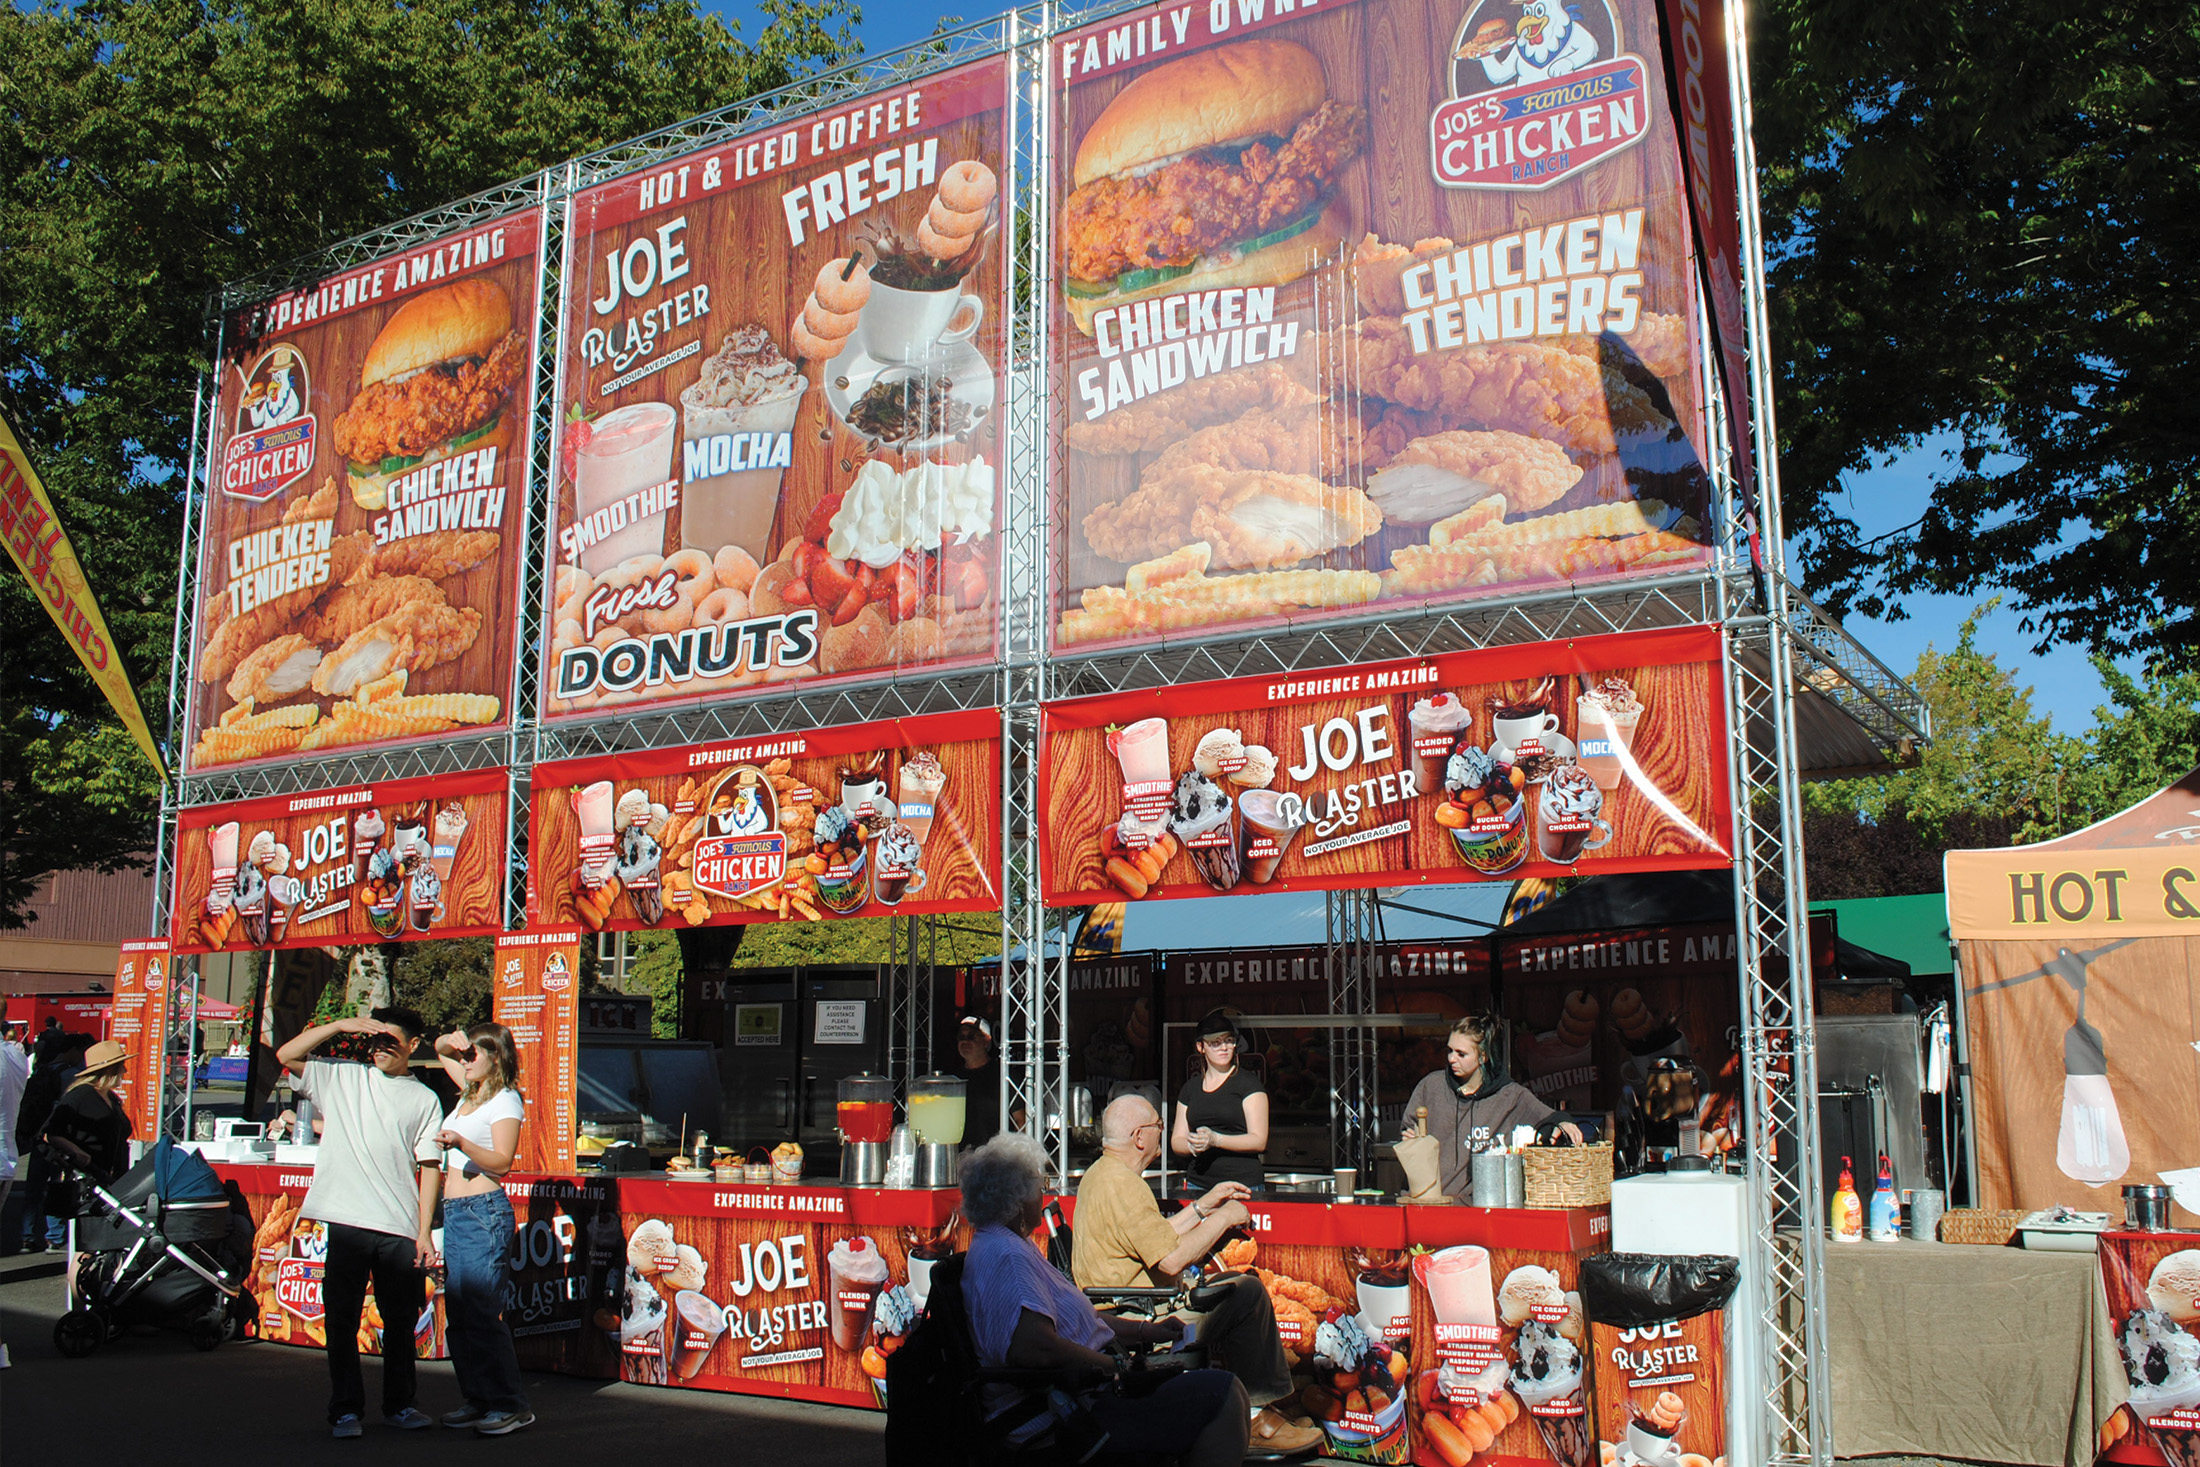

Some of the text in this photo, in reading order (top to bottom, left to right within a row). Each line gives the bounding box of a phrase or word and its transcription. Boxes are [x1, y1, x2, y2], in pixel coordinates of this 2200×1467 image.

[1063, 0, 1318, 80] FAMILY OW
[1440, 97, 1500, 140] JOE'S
[1442, 96, 1638, 176] CHICKEN
[640, 91, 921, 211] HOT & ICED COFFEE
[1512, 154, 1569, 182] RANCH
[782, 138, 938, 246] FRESH
[593, 216, 690, 315] JOE
[1401, 208, 1645, 311] CHICKEN
[250, 227, 505, 340] EXPERIENCE AMAZING
[1093, 287, 1275, 358] CHICKEN
[1400, 273, 1642, 356] TENDERS
[602, 342, 699, 394] NOT YOUR AVERAGE JOE
[1078, 321, 1299, 421] SANDWICH
[228, 436, 255, 463] JOE'S
[683, 433, 791, 483] MOCHA
[226, 442, 310, 488] CHICKEN
[253, 478, 278, 494] RANCH
[388, 447, 497, 511] CHICKEN
[374, 487, 505, 545] SANDWICH
[559, 479, 679, 561] SMOOTHIE
[229, 520, 333, 579] CHICKEN
[228, 553, 331, 619] TENDERS
[584, 569, 678, 640] Fresh
[557, 610, 818, 698] DONUTS
[1268, 667, 1438, 700] EXPERIENCE AMAZING
[689, 740, 806, 766] EXPERIENCE AMAZING
[1288, 705, 1393, 781] JOE
[1414, 738, 1453, 747] BLENDED
[1420, 747, 1447, 756] DRINK
[289, 791, 372, 811] EXPERIENCE AMAZING
[1124, 782, 1172, 797] SMOOTHIE
[901, 805, 931, 816] MOCHA
[580, 835, 615, 846] SMOOTHIE
[1305, 822, 1409, 855] NOT YOUR AVERAGE JOE
[1549, 823, 1590, 831] CHOCOLATE
[294, 817, 346, 870] JOE
[697, 840, 724, 861] JOE'S
[1249, 848, 1279, 856] COFFEE
[1254, 839, 1272, 847] ICED
[696, 854, 780, 884] CHICKEN
[724, 881, 749, 892] RANCH
[2007, 866, 2200, 924] HOT &
[123, 941, 168, 951] EXPERIENCE AMAZING
[499, 933, 576, 946] EXPERIENCE AMAZING
[505, 959, 520, 974] JOE
[1520, 938, 1671, 973] EXPERIENCE
[1071, 965, 1141, 991] AMAZING
[590, 1002, 636, 1030] ICE
[501, 1182, 605, 1200] XPERIENCE AMAZING
[714, 1193, 844, 1212] EXPERIENCE AMAZING
[511, 1215, 576, 1271] JOE
[281, 1262, 304, 1278] JOE'S
[730, 1234, 810, 1297] JOE
[838, 1291, 870, 1300] BLENDED
[844, 1301, 865, 1309] DRINK
[685, 1340, 709, 1349] COFFEE
[1435, 1325, 1500, 1341] SMOOTHIE
[742, 1349, 822, 1367] NOT YOUR AVERAGE JOE
[1456, 1366, 1480, 1374] MANGO
[1450, 1396, 1478, 1404] DONUTS
[1533, 1406, 1565, 1415] BLENDED
[1346, 1411, 1373, 1421] BUCKET
[1351, 1421, 1380, 1433] DONUTS
[2150, 1419, 2192, 1428] BLENDED
[2173, 1411, 2199, 1419] OREO
